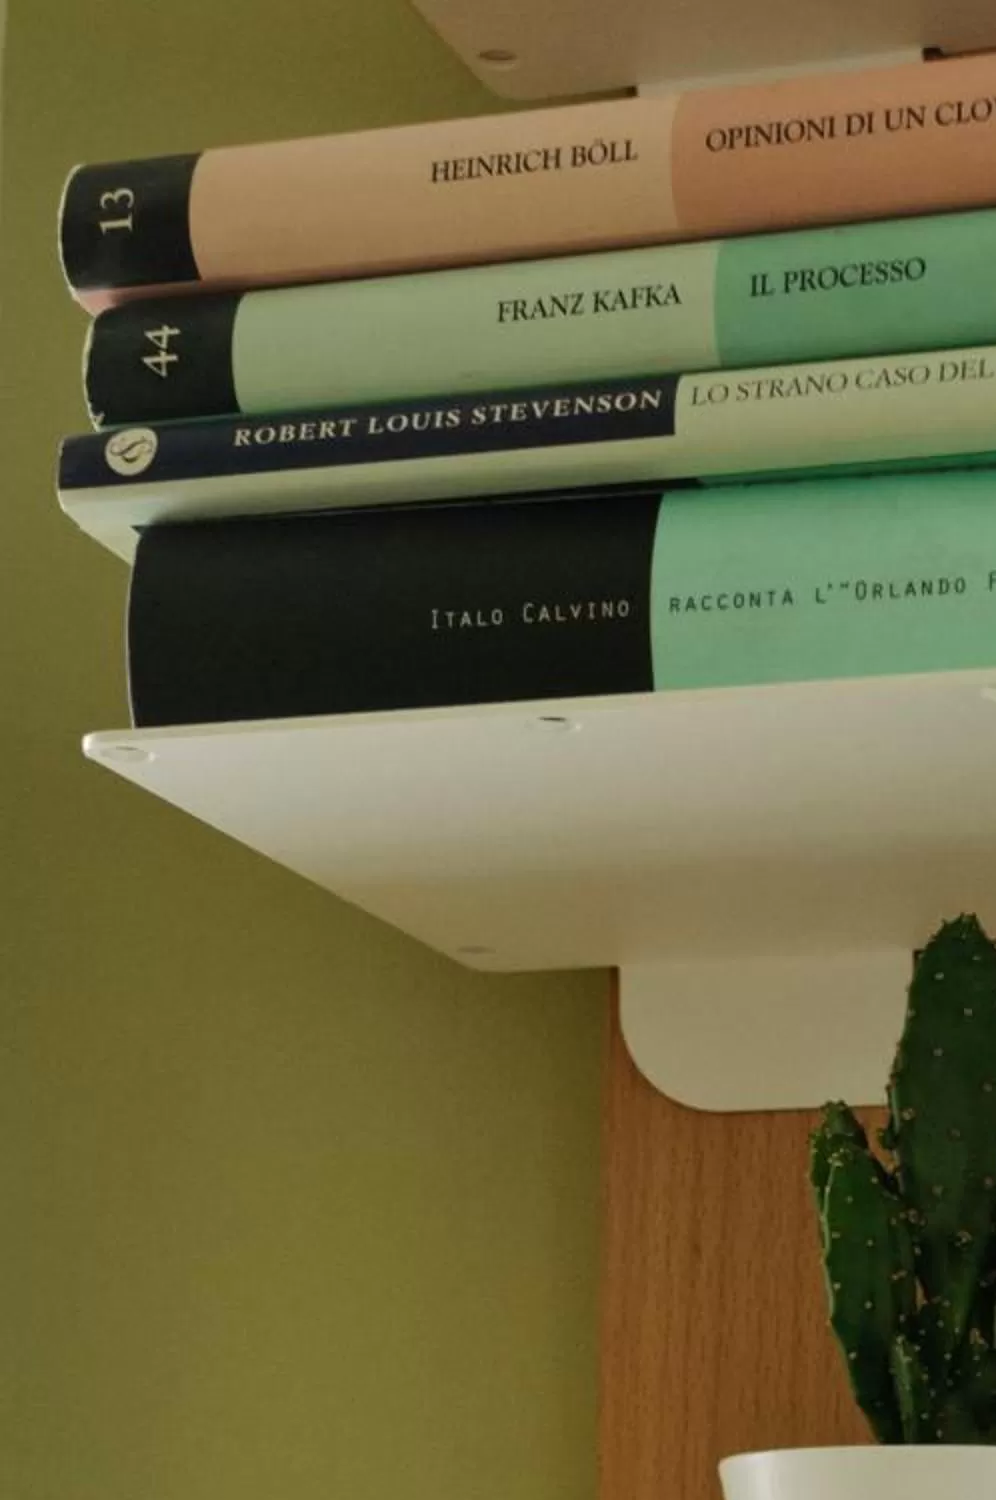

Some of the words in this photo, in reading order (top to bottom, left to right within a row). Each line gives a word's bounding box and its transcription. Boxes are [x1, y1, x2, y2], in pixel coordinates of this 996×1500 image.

[705, 115, 841, 153] OPINIONI
[845, 111, 876, 138] DI
[884, 105, 927, 134] UN
[431, 148, 563, 184] HEINRICH
[570, 138, 639, 169] BÖLL
[100, 187, 135, 236] 13
[750, 272, 775, 298] IL
[783, 257, 927, 296] PROCESSO
[497, 292, 585, 324] FRANZ
[592, 282, 683, 315] KAFKA
[141, 325, 181, 378] 44
[691, 383, 730, 406] LO
[736, 371, 849, 402] STRANO
[854, 363, 931, 389] CASO
[938, 358, 994, 384] DEL
[233, 417, 358, 448] ROBERT
[368, 410, 462, 436] LOUIS
[471, 389, 664, 426] STEVENSON
[668, 587, 795, 614] RACCONTA
